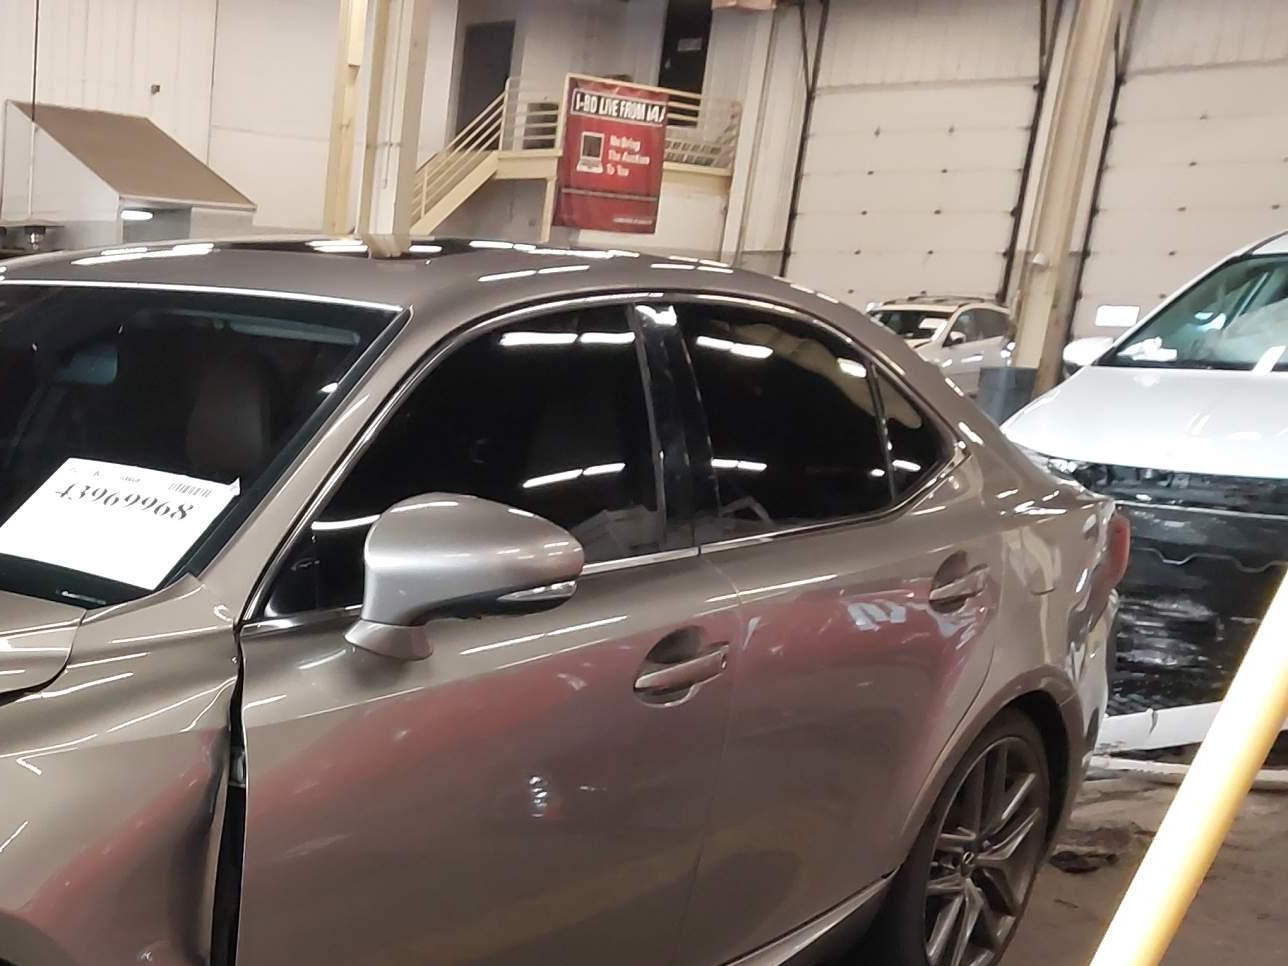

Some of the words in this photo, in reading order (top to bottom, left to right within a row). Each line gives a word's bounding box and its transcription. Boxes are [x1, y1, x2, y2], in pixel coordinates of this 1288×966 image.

[599, 97, 619, 117] LIVE
[619, 100, 646, 120] FROM
[55, 482, 195, 521] 43969968
